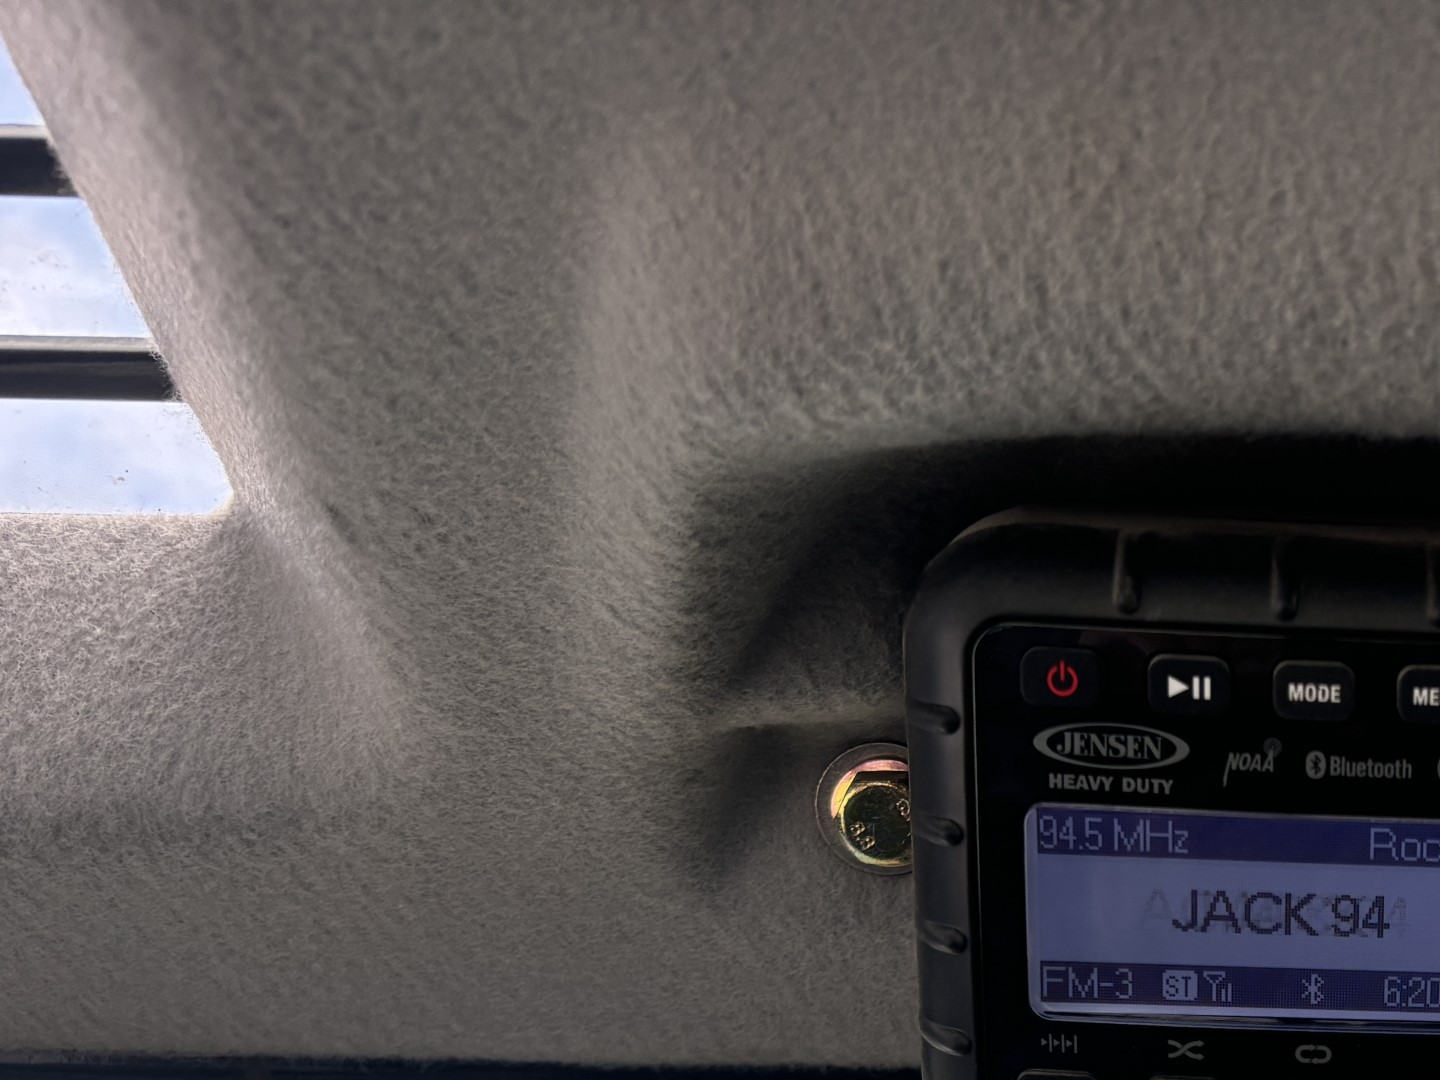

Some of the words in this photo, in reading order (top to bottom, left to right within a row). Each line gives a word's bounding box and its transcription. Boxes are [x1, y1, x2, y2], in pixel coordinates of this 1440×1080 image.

[1288, 683, 1341, 703] MODE
[1056, 731, 1163, 761] JENSEN
[1222, 747, 1275, 787] NOAA
[1329, 755, 1413, 779] Bluetooth
[1048, 772, 1114, 792] HEAVY
[1122, 777, 1174, 795] DUTY
[1039, 815, 1103, 851] 94.5
[1113, 818, 1189, 854] MHz
[1172, 889, 1319, 937] JACK
[1331, 894, 1390, 938] 94
[1042, 966, 1133, 1000] FM-3
[1166, 975, 1192, 998] ST
